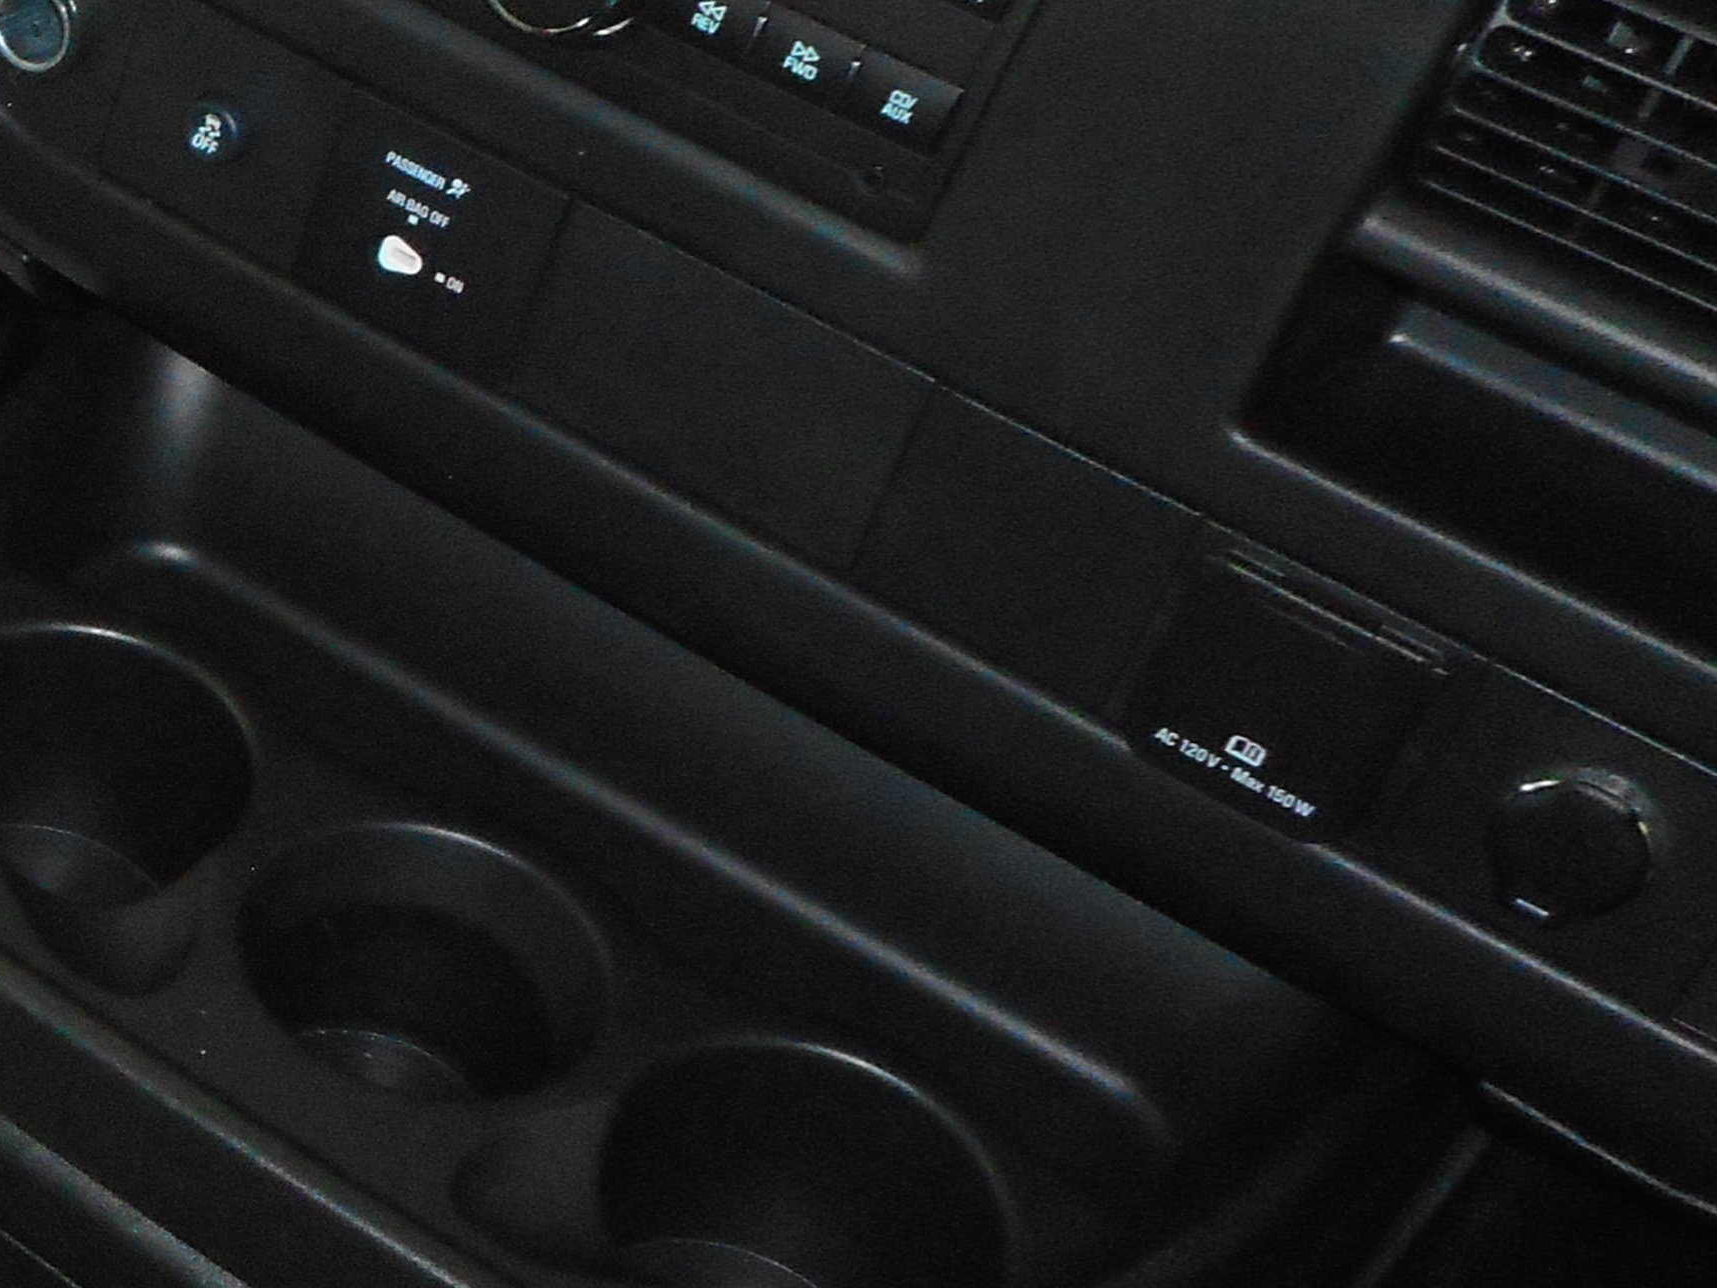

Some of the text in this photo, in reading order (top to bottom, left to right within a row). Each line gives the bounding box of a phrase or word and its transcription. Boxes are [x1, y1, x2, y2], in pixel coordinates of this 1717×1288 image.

[691, 13, 721, 35] REV
[783, 56, 818, 81] FWD
[889, 89, 919, 110] CD/
[880, 102, 914, 125] AUX
[190, 132, 219, 155] OFF
[385, 149, 447, 191] PASSENGER
[386, 188, 451, 229] AIR BAG OFF
[445, 275, 465, 295] ON
[1154, 726, 1181, 747] AC
[1229, 766, 1266, 794] Max
